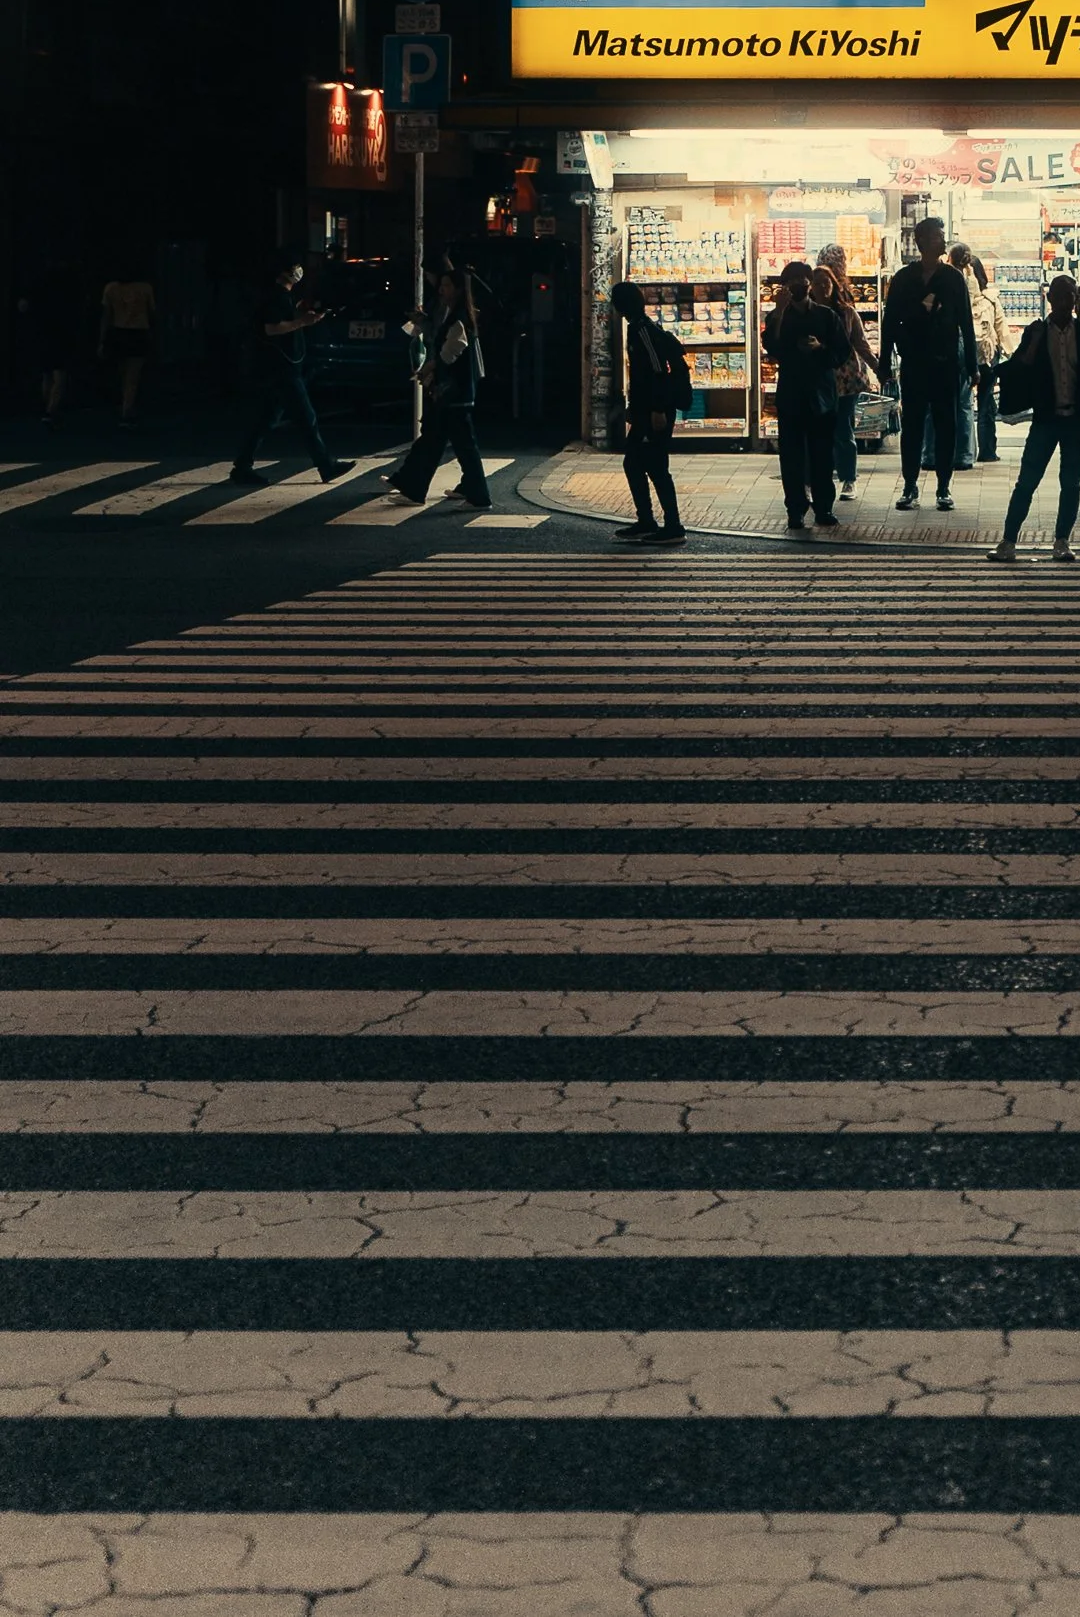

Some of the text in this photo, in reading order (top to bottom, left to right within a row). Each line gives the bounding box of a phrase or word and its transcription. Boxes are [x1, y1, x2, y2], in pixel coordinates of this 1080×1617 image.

[573, 29, 922, 58] Matsumoto KiYoshi
[401, 44, 438, 103] P
[888, 171, 975, 185] スタートアップ
[977, 152, 1065, 185] SALE
